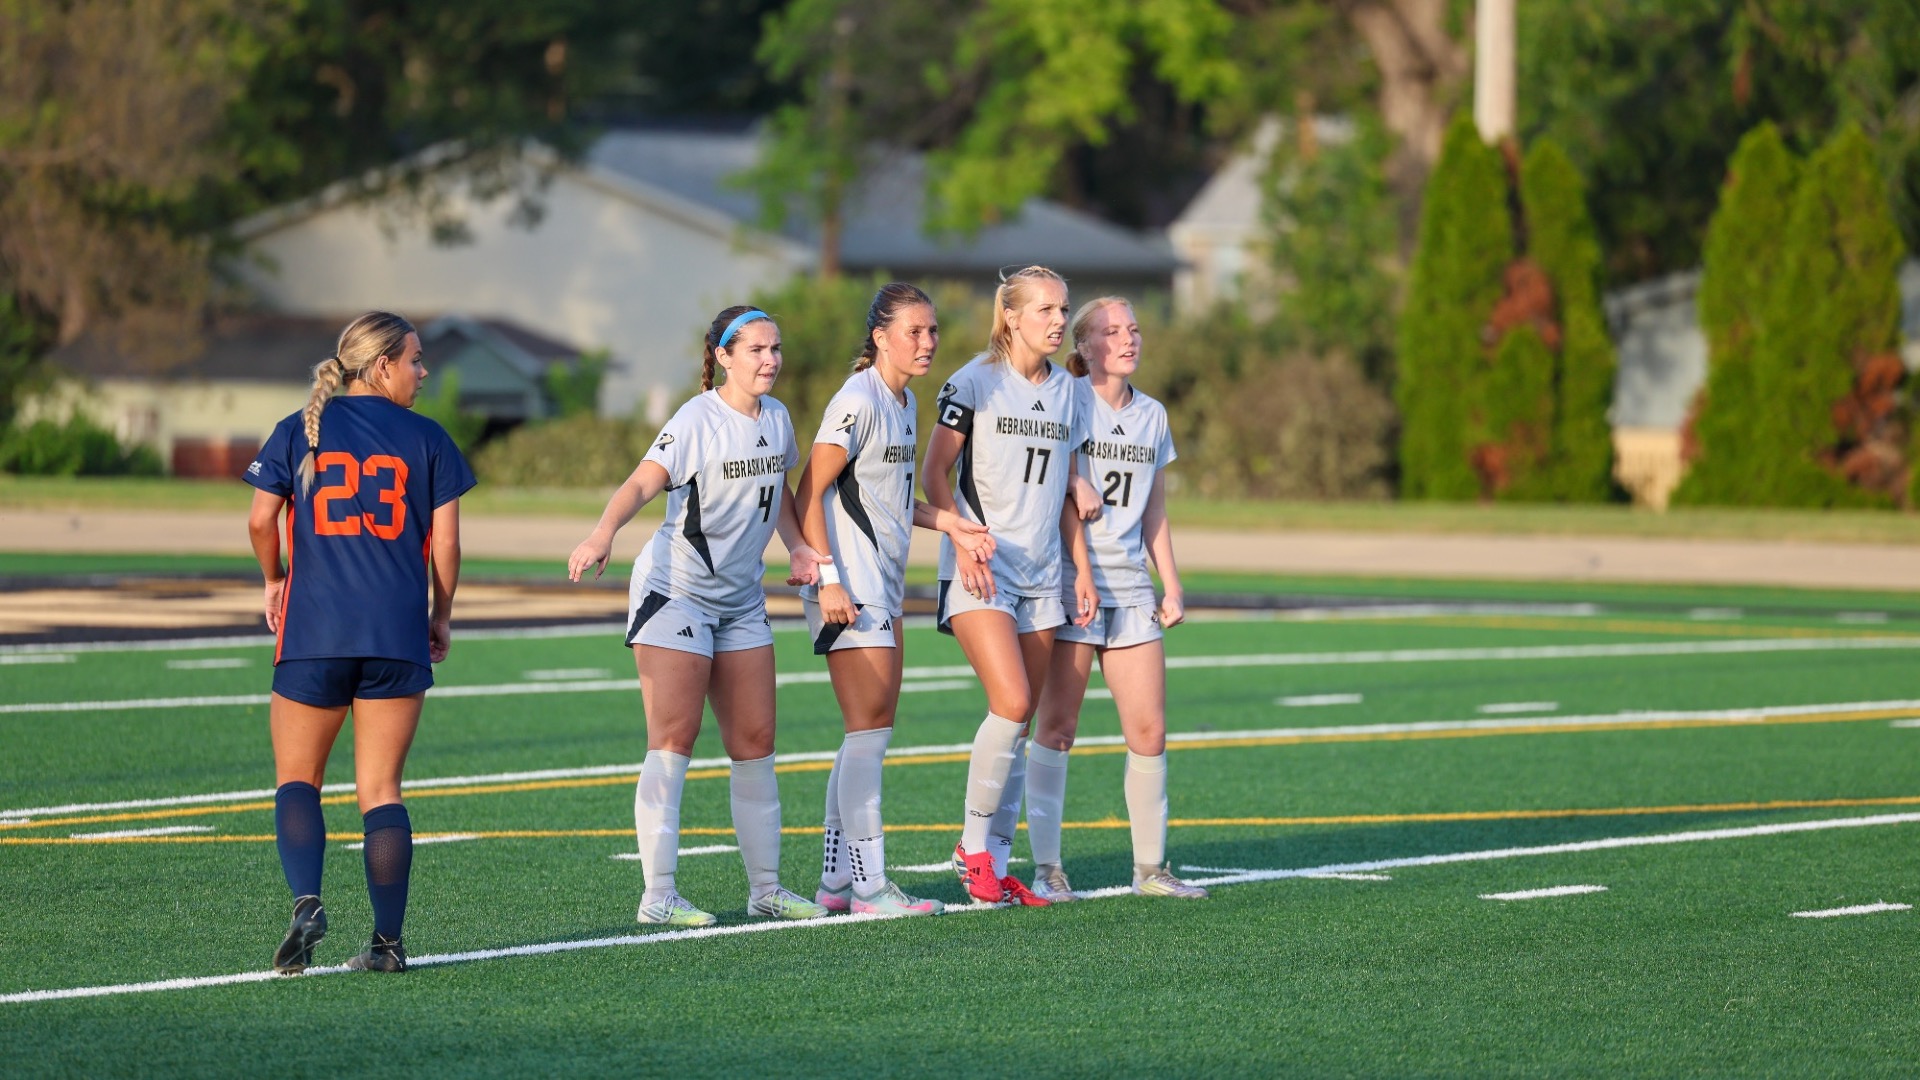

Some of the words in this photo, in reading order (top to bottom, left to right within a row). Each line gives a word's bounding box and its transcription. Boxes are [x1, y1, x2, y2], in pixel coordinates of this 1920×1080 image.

[942, 404, 963, 426] C
[996, 416, 1039, 438] NEBRASKA
[723, 457, 766, 480] NEBRASKA
[1023, 447, 1052, 485] 17
[1120, 443, 1156, 464] WESLEYAN
[313, 451, 409, 541] 23
[757, 484, 775, 523] 4
[905, 472, 913, 510] 7
[1102, 470, 1134, 508] 21
